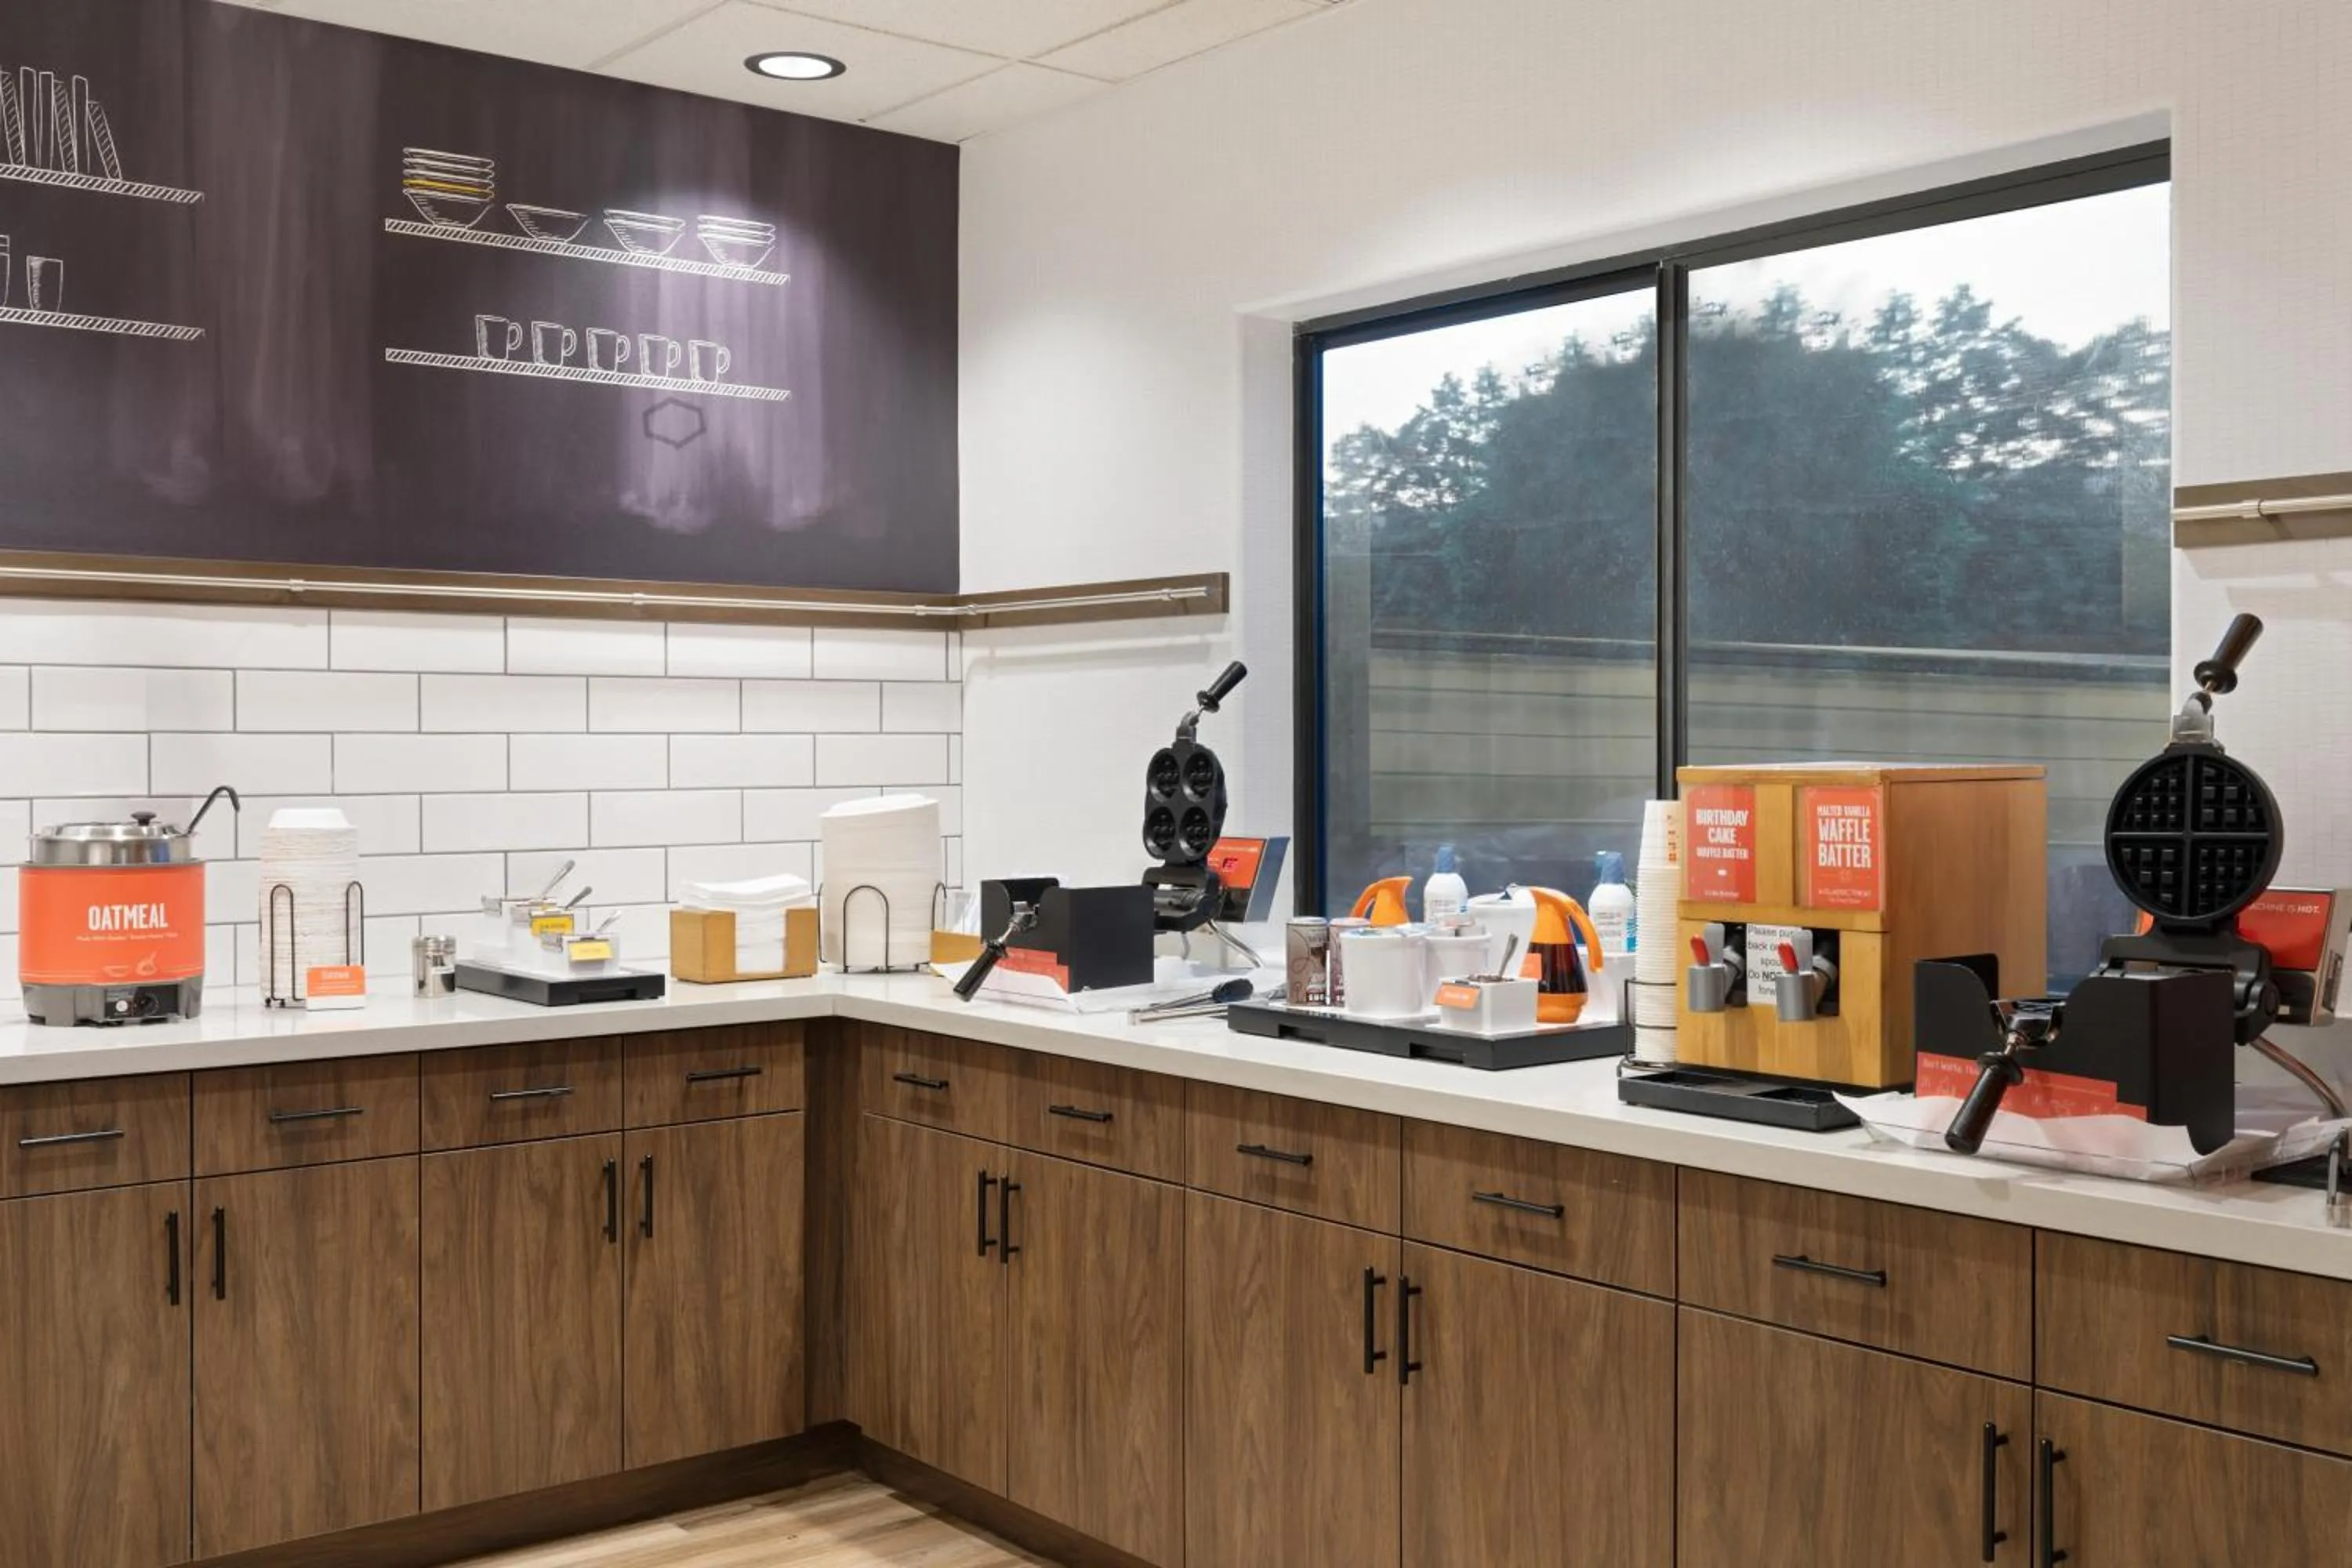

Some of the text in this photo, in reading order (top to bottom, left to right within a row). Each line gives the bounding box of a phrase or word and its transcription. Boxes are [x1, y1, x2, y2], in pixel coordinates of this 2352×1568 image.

[1696, 808, 1748, 826] BIRTHDAY
[1708, 827, 1737, 844] CAKE
[1818, 818, 1871, 843] WAFFLE
[1818, 844, 1871, 868] BATTER
[88, 902, 169, 931] OATMEAL
[1748, 925, 1777, 936] Please
[1748, 942, 1767, 951] back
[1760, 957, 1782, 967] spou
[1748, 969, 1759, 979] Do
